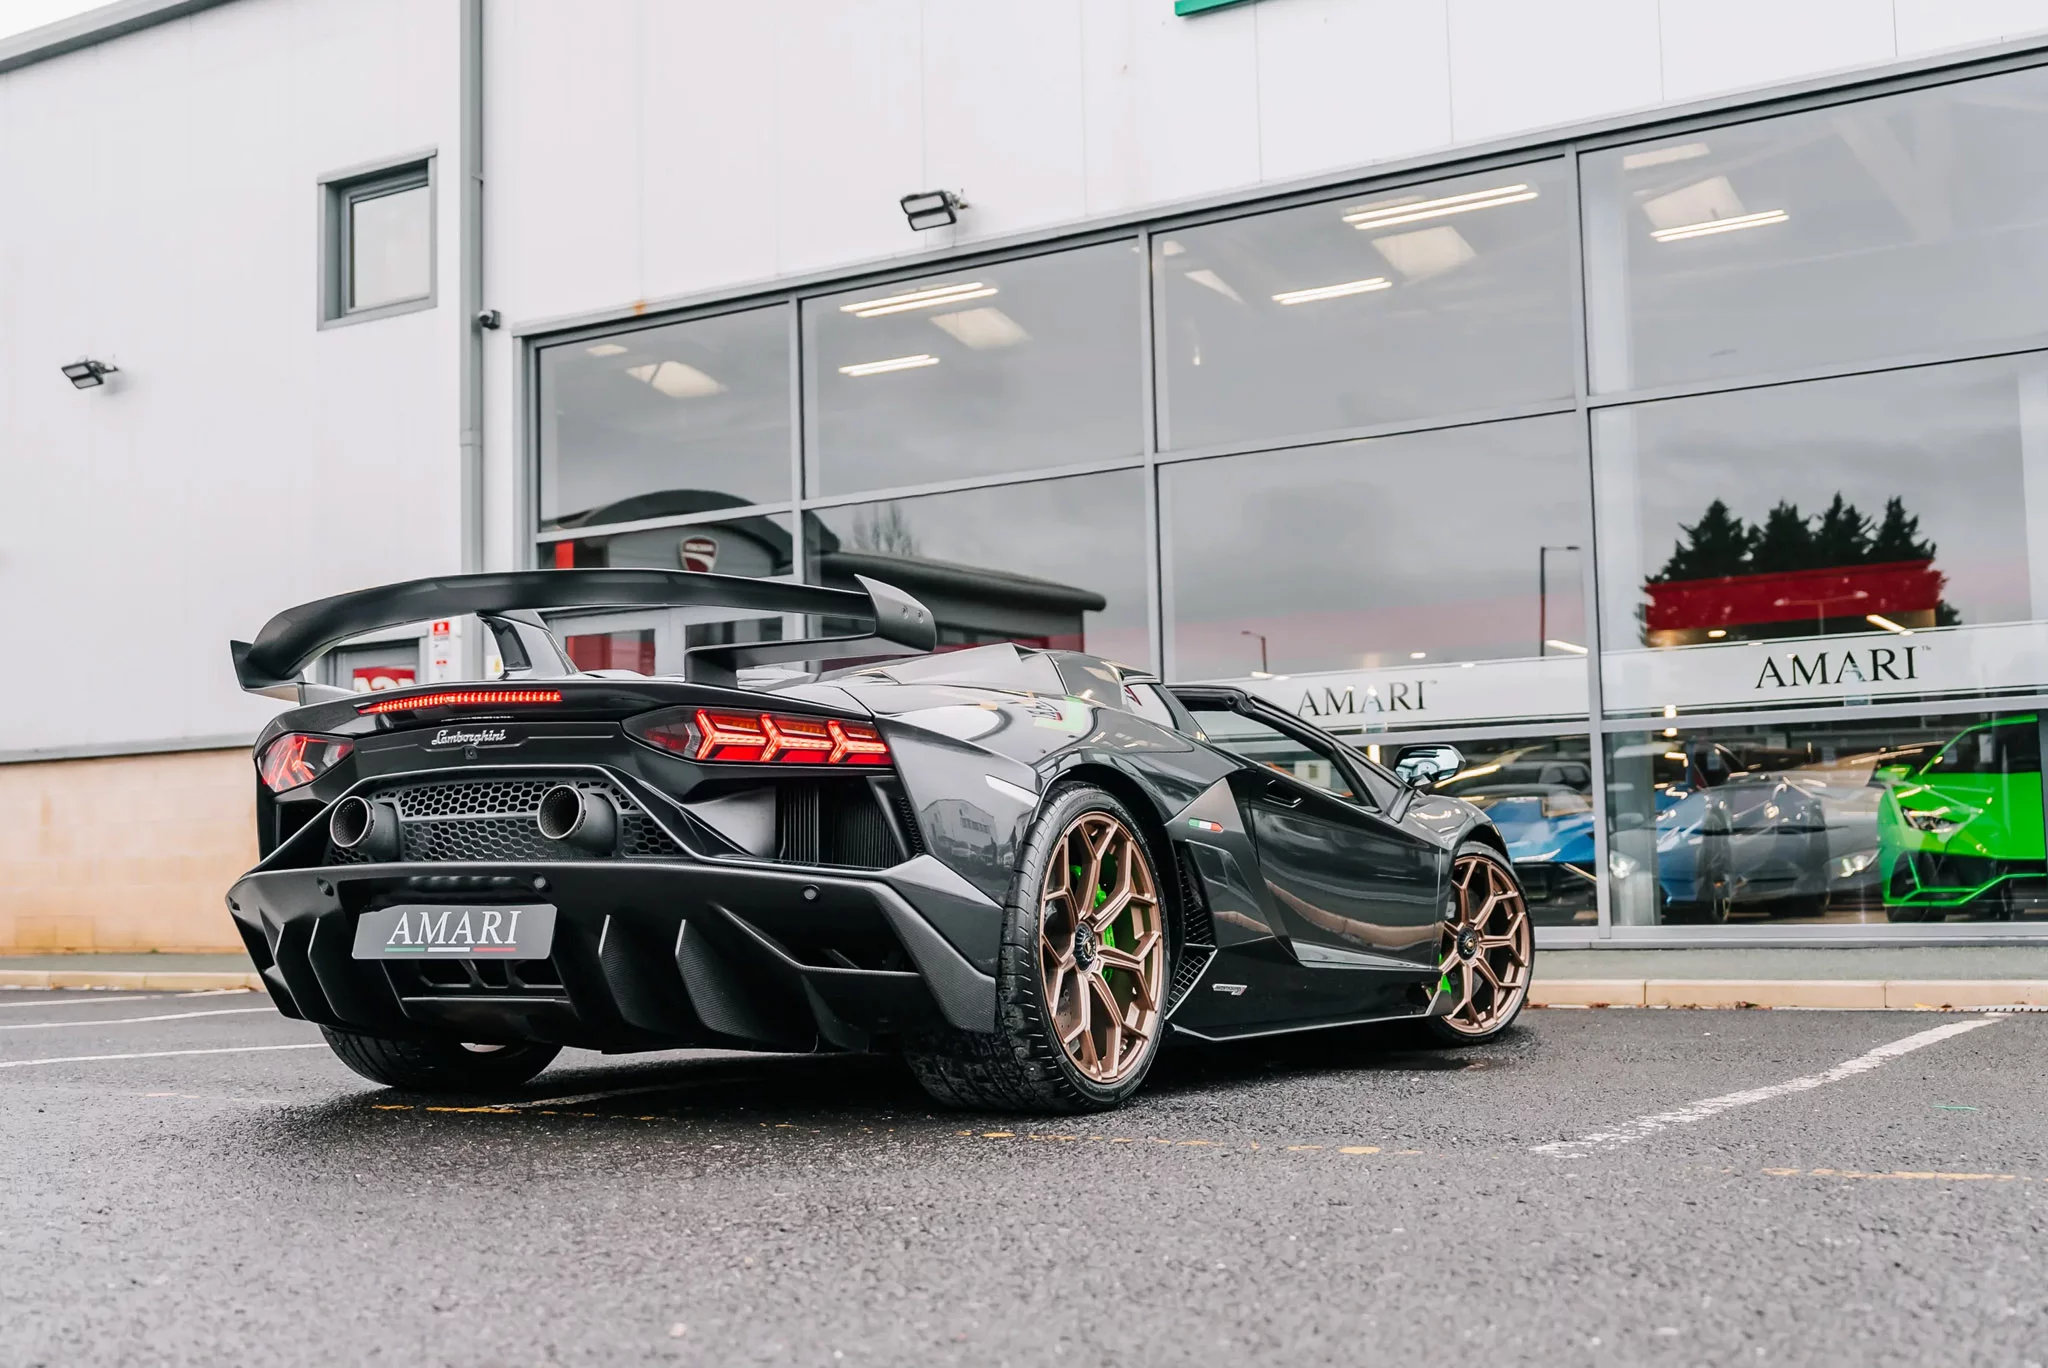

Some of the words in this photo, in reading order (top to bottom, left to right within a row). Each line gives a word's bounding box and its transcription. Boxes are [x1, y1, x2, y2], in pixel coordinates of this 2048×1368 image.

[1754, 645, 1919, 690] AMARI
[1297, 679, 1427, 717] AMARI
[430, 728, 507, 746] Lamborghini
[386, 910, 522, 945] AMARI
